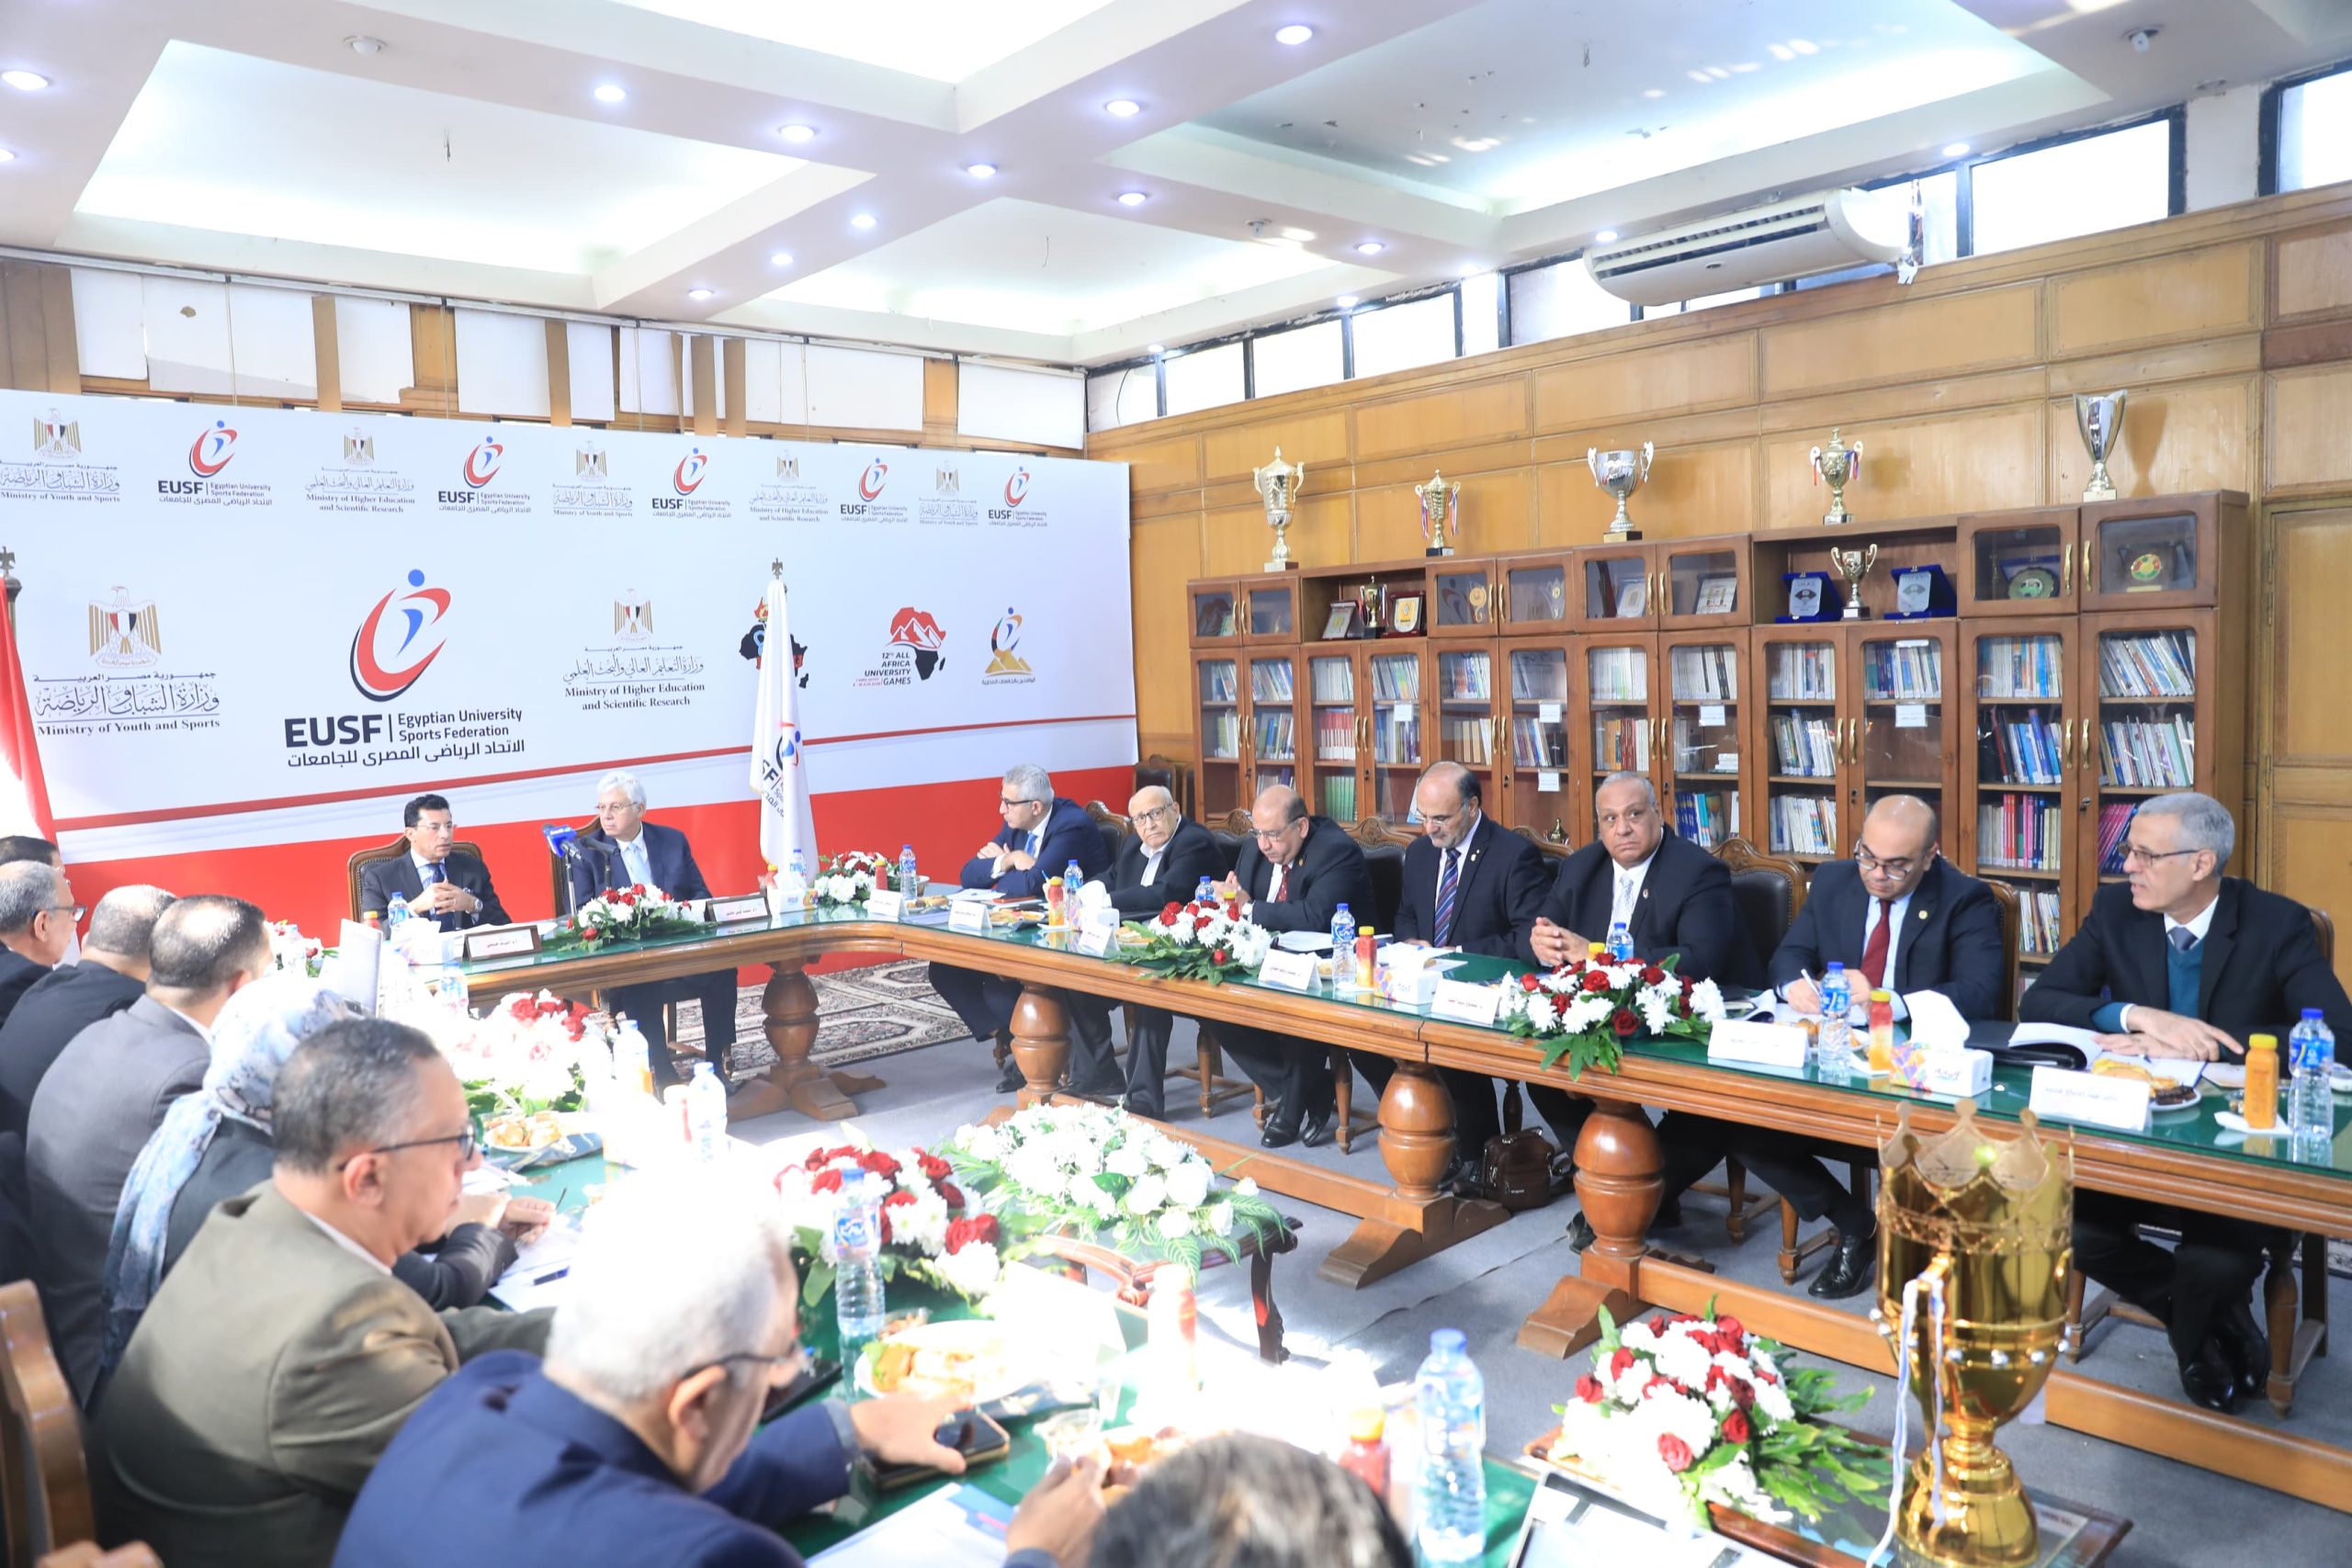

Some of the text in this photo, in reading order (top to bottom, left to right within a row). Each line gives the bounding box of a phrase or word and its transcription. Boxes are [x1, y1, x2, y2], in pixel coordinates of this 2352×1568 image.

[158, 480, 204, 494] EUSF
[210, 482, 271, 491] Egyptian University
[0, 491, 37, 501] Ministry
[306, 493, 339, 502] Ministry
[351, 495, 377, 504] Higher
[379, 496, 415, 504] Education
[438, 491, 475, 503] EUSF
[481, 491, 530, 501] Egyptian University
[371, 505, 403, 513] Research
[651, 498, 684, 510] EUSF
[841, 504, 867, 514] EUSF
[989, 509, 1012, 520] EUSF
[865, 669, 910, 677] UNIVERSITY
[884, 677, 911, 685] GAMES
[565, 682, 705, 698] Ministry of Higher Education
[582, 696, 690, 710] and Scientific Research
[398, 707, 522, 728] Egyptian University
[38, 718, 220, 736] Ministry of Youth and Sports
[285, 714, 382, 748] EUSF
[399, 725, 509, 743] Sports Federation
[288, 739, 525, 767] الاتحاد الرياضى المصرى للجامعات
